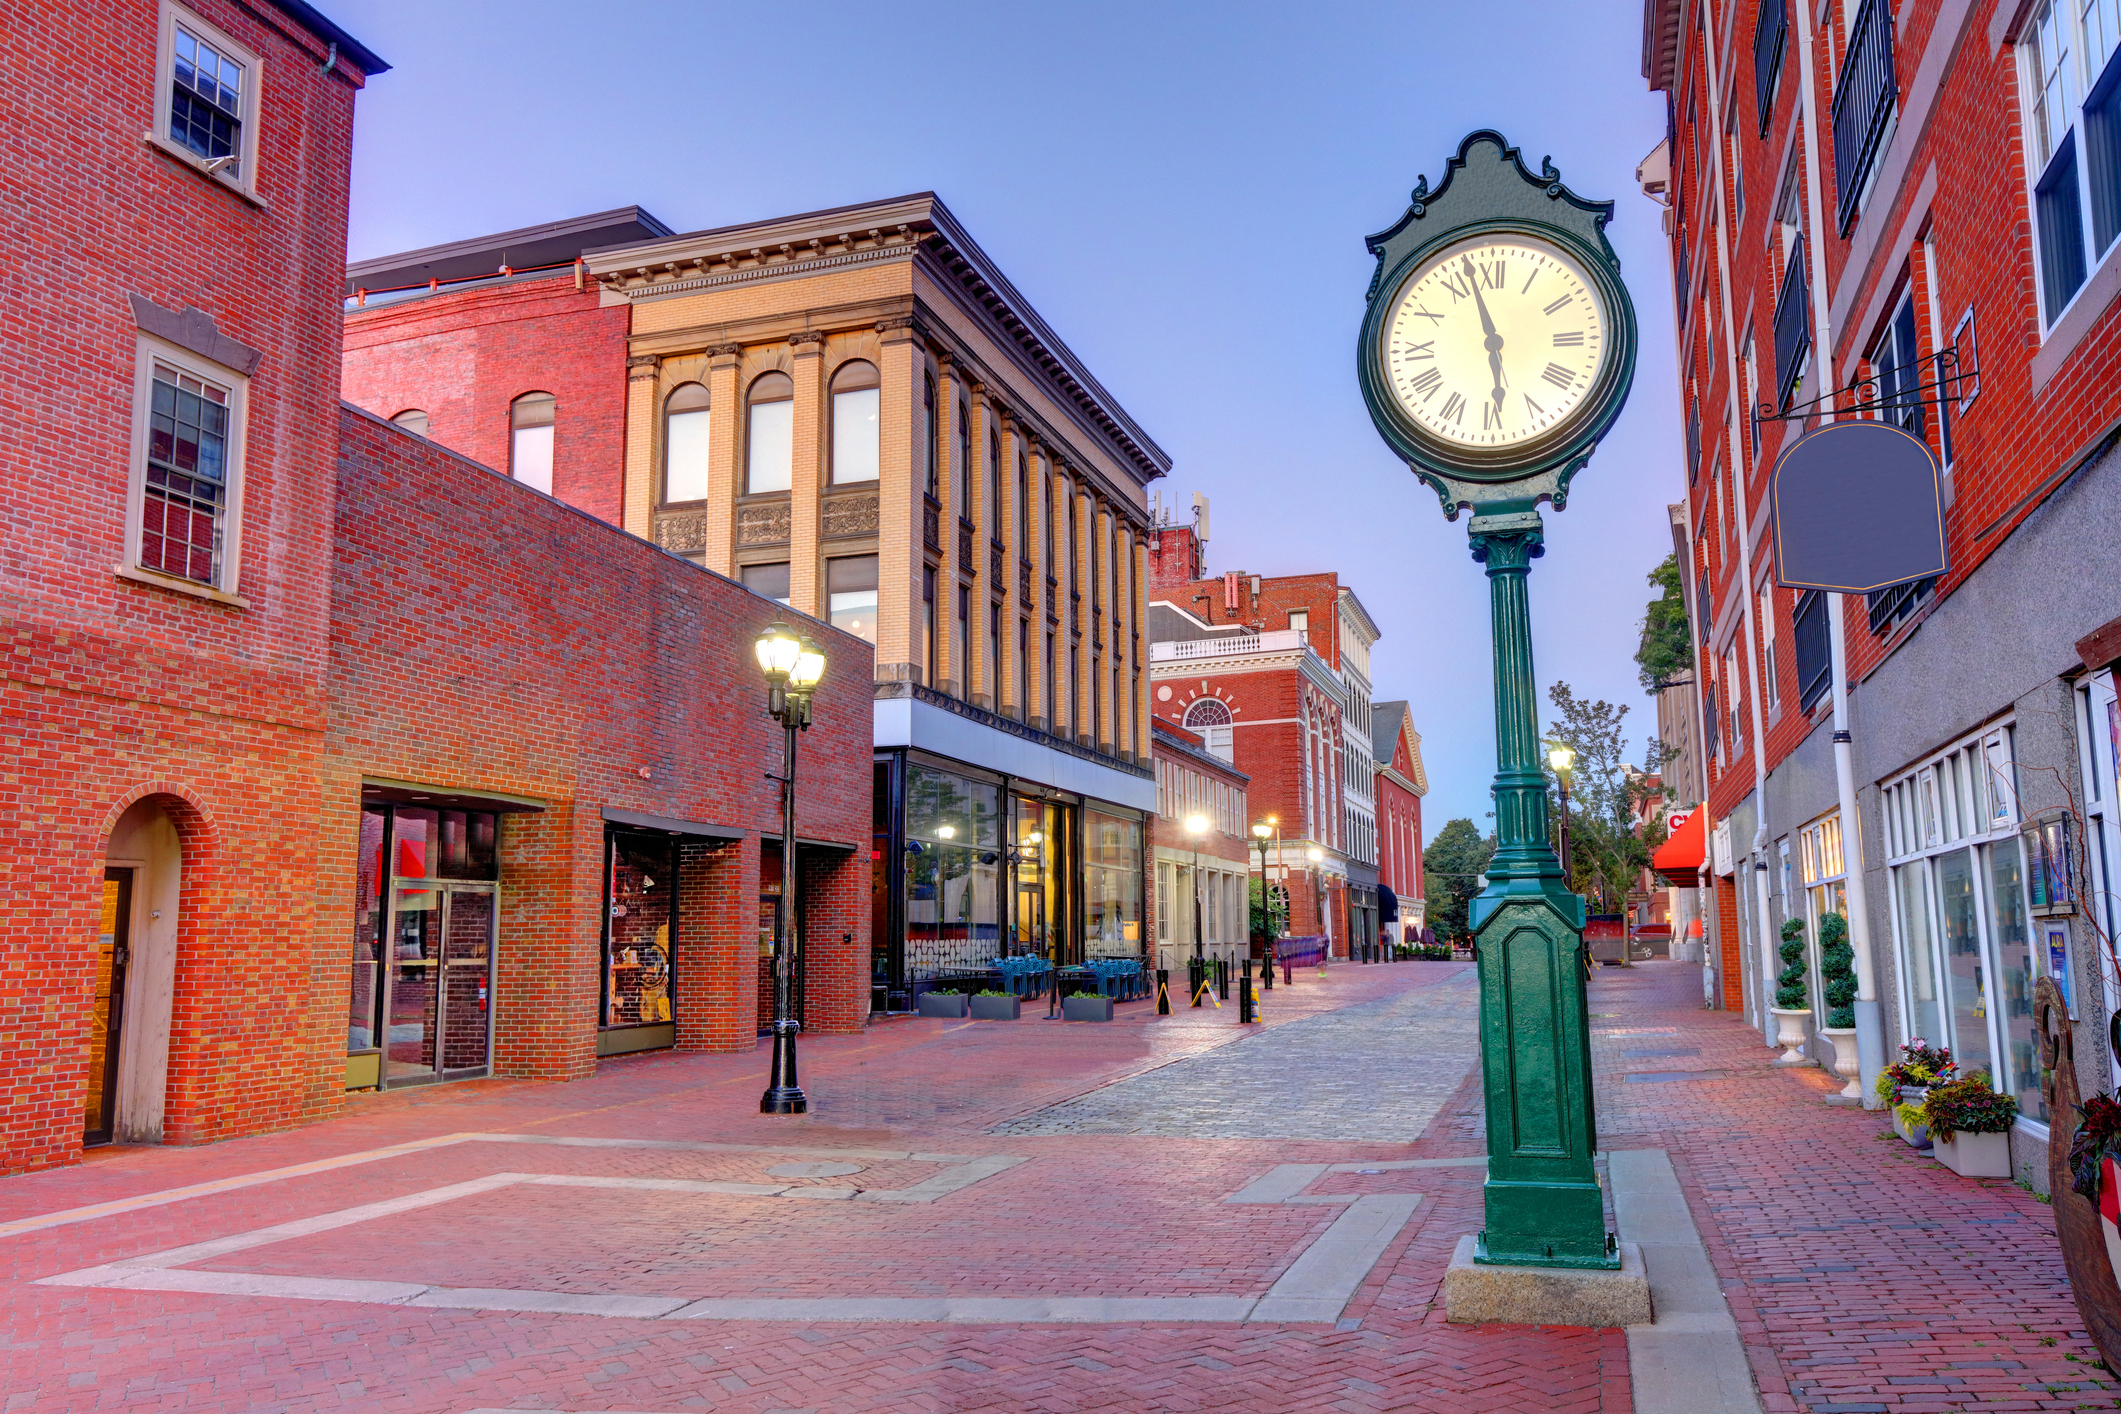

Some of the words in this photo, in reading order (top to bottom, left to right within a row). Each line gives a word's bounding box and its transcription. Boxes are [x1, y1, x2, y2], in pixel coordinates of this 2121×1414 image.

[1440, 271, 1471, 304] XI
[1479, 260, 1506, 291] XII
[1413, 303, 1445, 327] X
[1543, 293, 1574, 316] II
[1405, 340, 1435, 361] IX
[1552, 331, 1584, 347] III
[1410, 366, 1445, 403] VIII
[1439, 391, 1467, 425] VII
